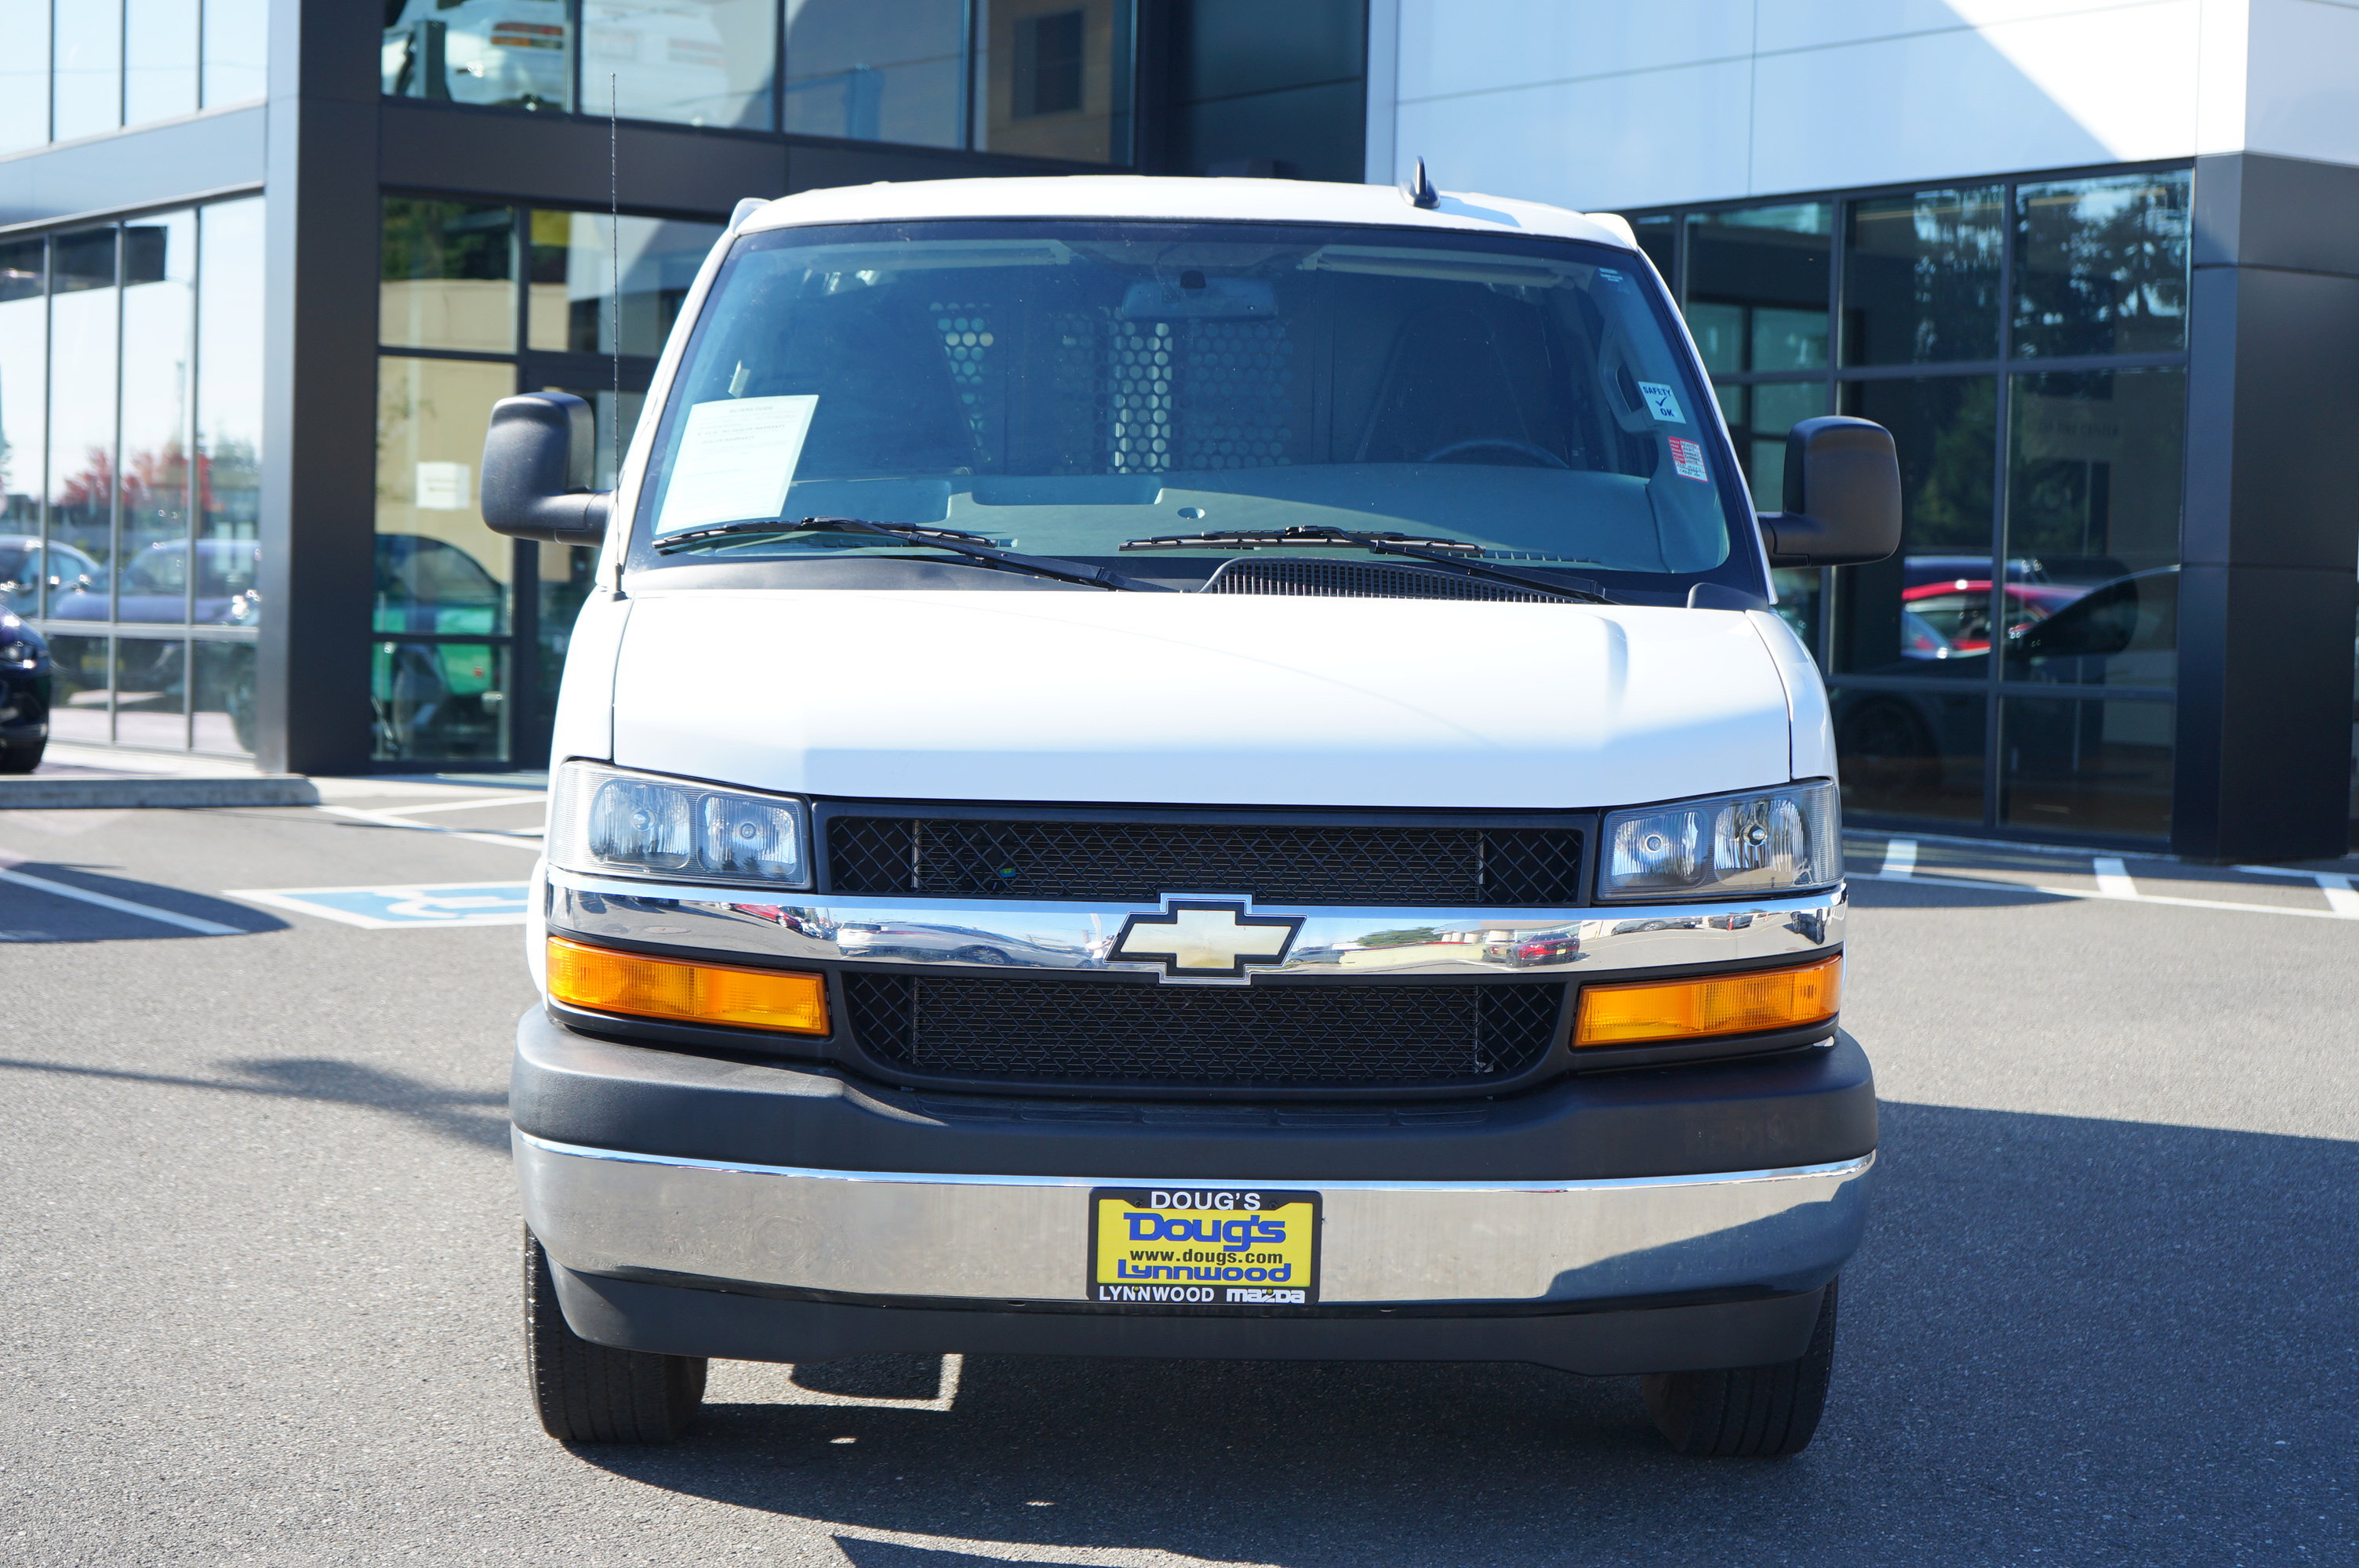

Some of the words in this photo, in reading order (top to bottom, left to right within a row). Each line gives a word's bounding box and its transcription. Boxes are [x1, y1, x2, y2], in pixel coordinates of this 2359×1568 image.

[1643, 387, 1670, 396] SAFETY
[1151, 1192, 1260, 1210] DOUG'S
[1123, 1212, 1286, 1252] Doug's
[1130, 1249, 1282, 1265] www.dougs.com
[1118, 1259, 1291, 1282] Lynnwood
[1099, 1286, 1214, 1302] LYNNWOOD
